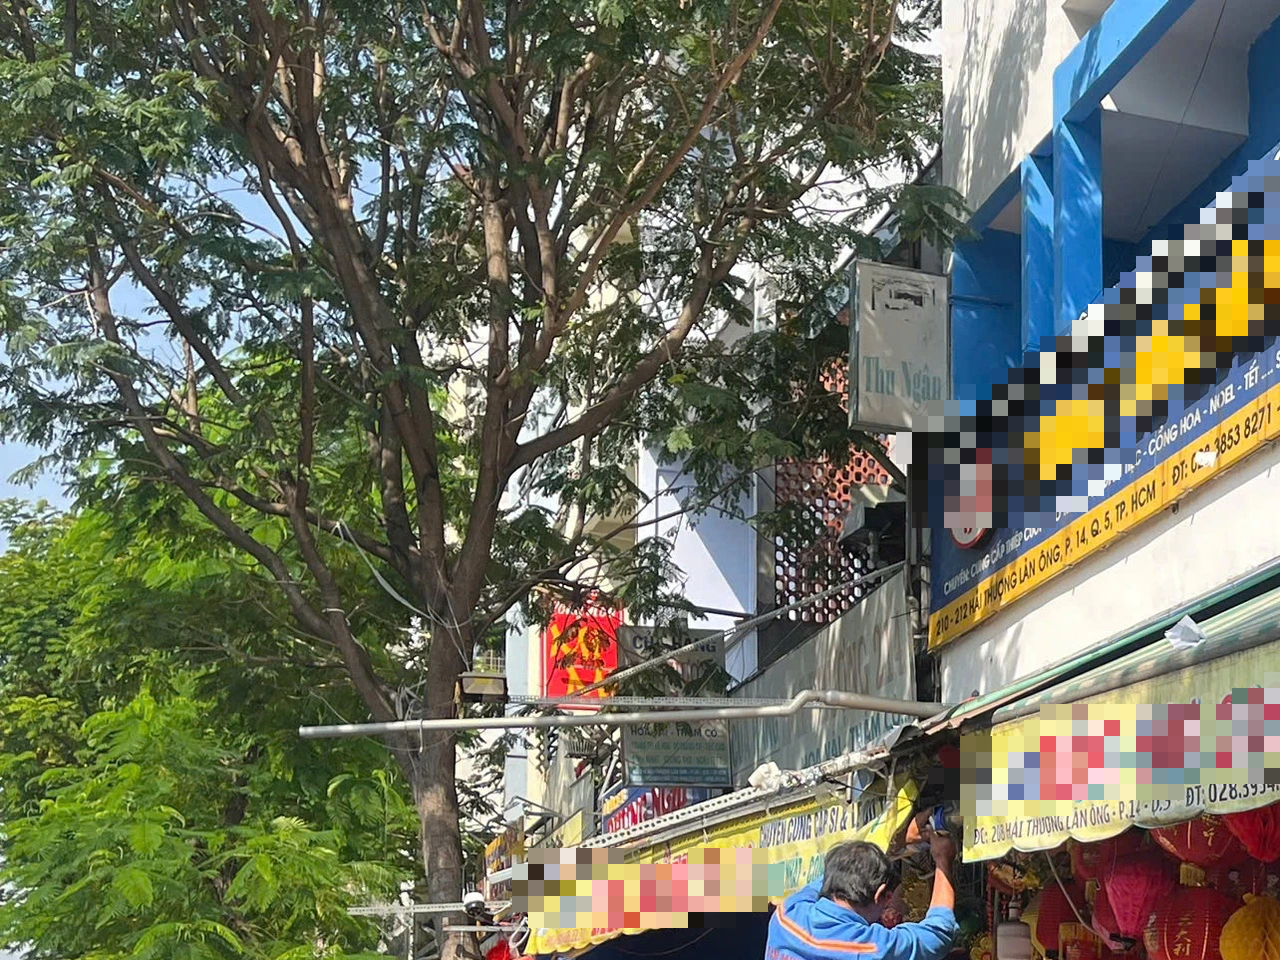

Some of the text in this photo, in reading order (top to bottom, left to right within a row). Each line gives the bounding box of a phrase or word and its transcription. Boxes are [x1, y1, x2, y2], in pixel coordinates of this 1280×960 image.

[1180, 413, 1201, 436] HOA
[1209, 383, 1236, 415] NOEL
[954, 604, 968, 626] 212
[1131, 480, 1156, 513] HCM
[1243, 403, 1272, 440] 8271
